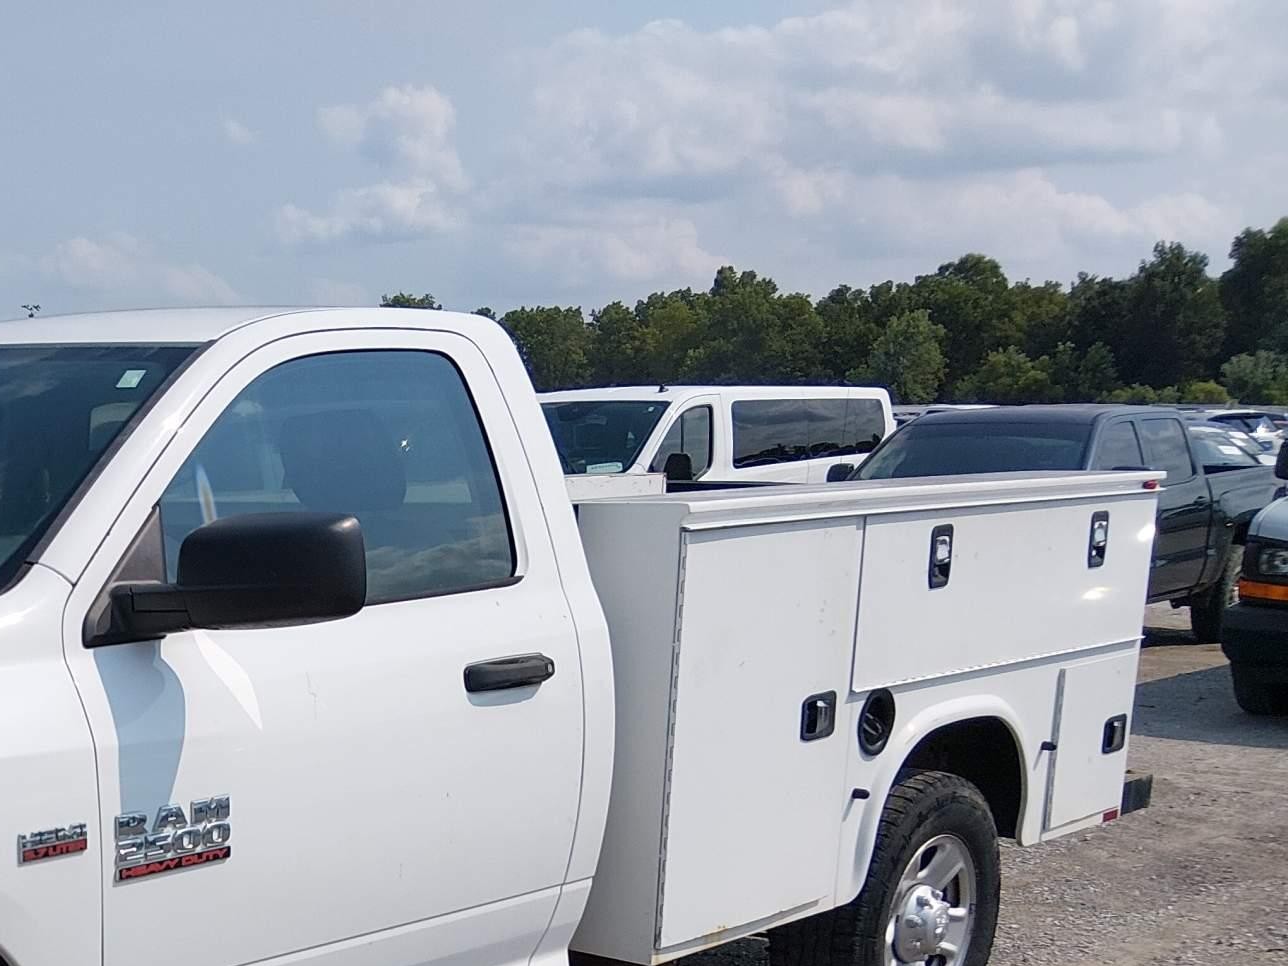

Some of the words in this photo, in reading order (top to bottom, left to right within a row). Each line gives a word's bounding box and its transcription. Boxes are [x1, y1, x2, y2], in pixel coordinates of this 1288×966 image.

[114, 794, 231, 836] RAM
[17, 823, 88, 847] HEMI
[48, 839, 88, 856] LITER
[115, 821, 231, 865] 2500
[121, 859, 180, 880] HEAVY
[181, 848, 228, 867] DUTY
